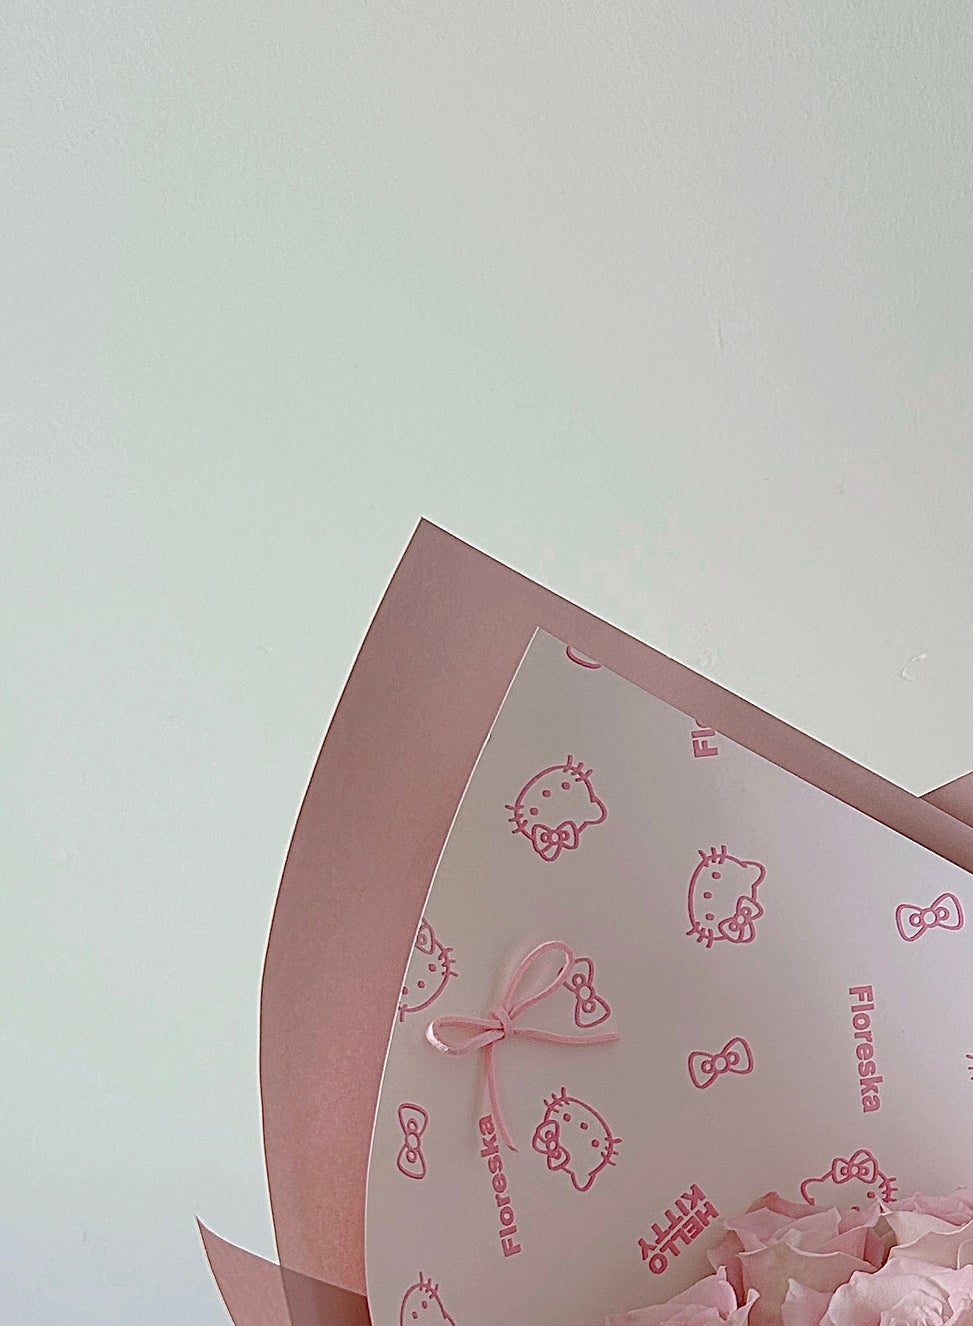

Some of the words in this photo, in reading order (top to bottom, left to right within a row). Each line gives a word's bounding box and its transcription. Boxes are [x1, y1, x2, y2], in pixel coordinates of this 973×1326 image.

[849, 985, 883, 1113] Floreska
[479, 1114, 522, 1257] Floreska
[638, 1184, 706, 1260] KITTY
[649, 1201, 719, 1274] HELLO
